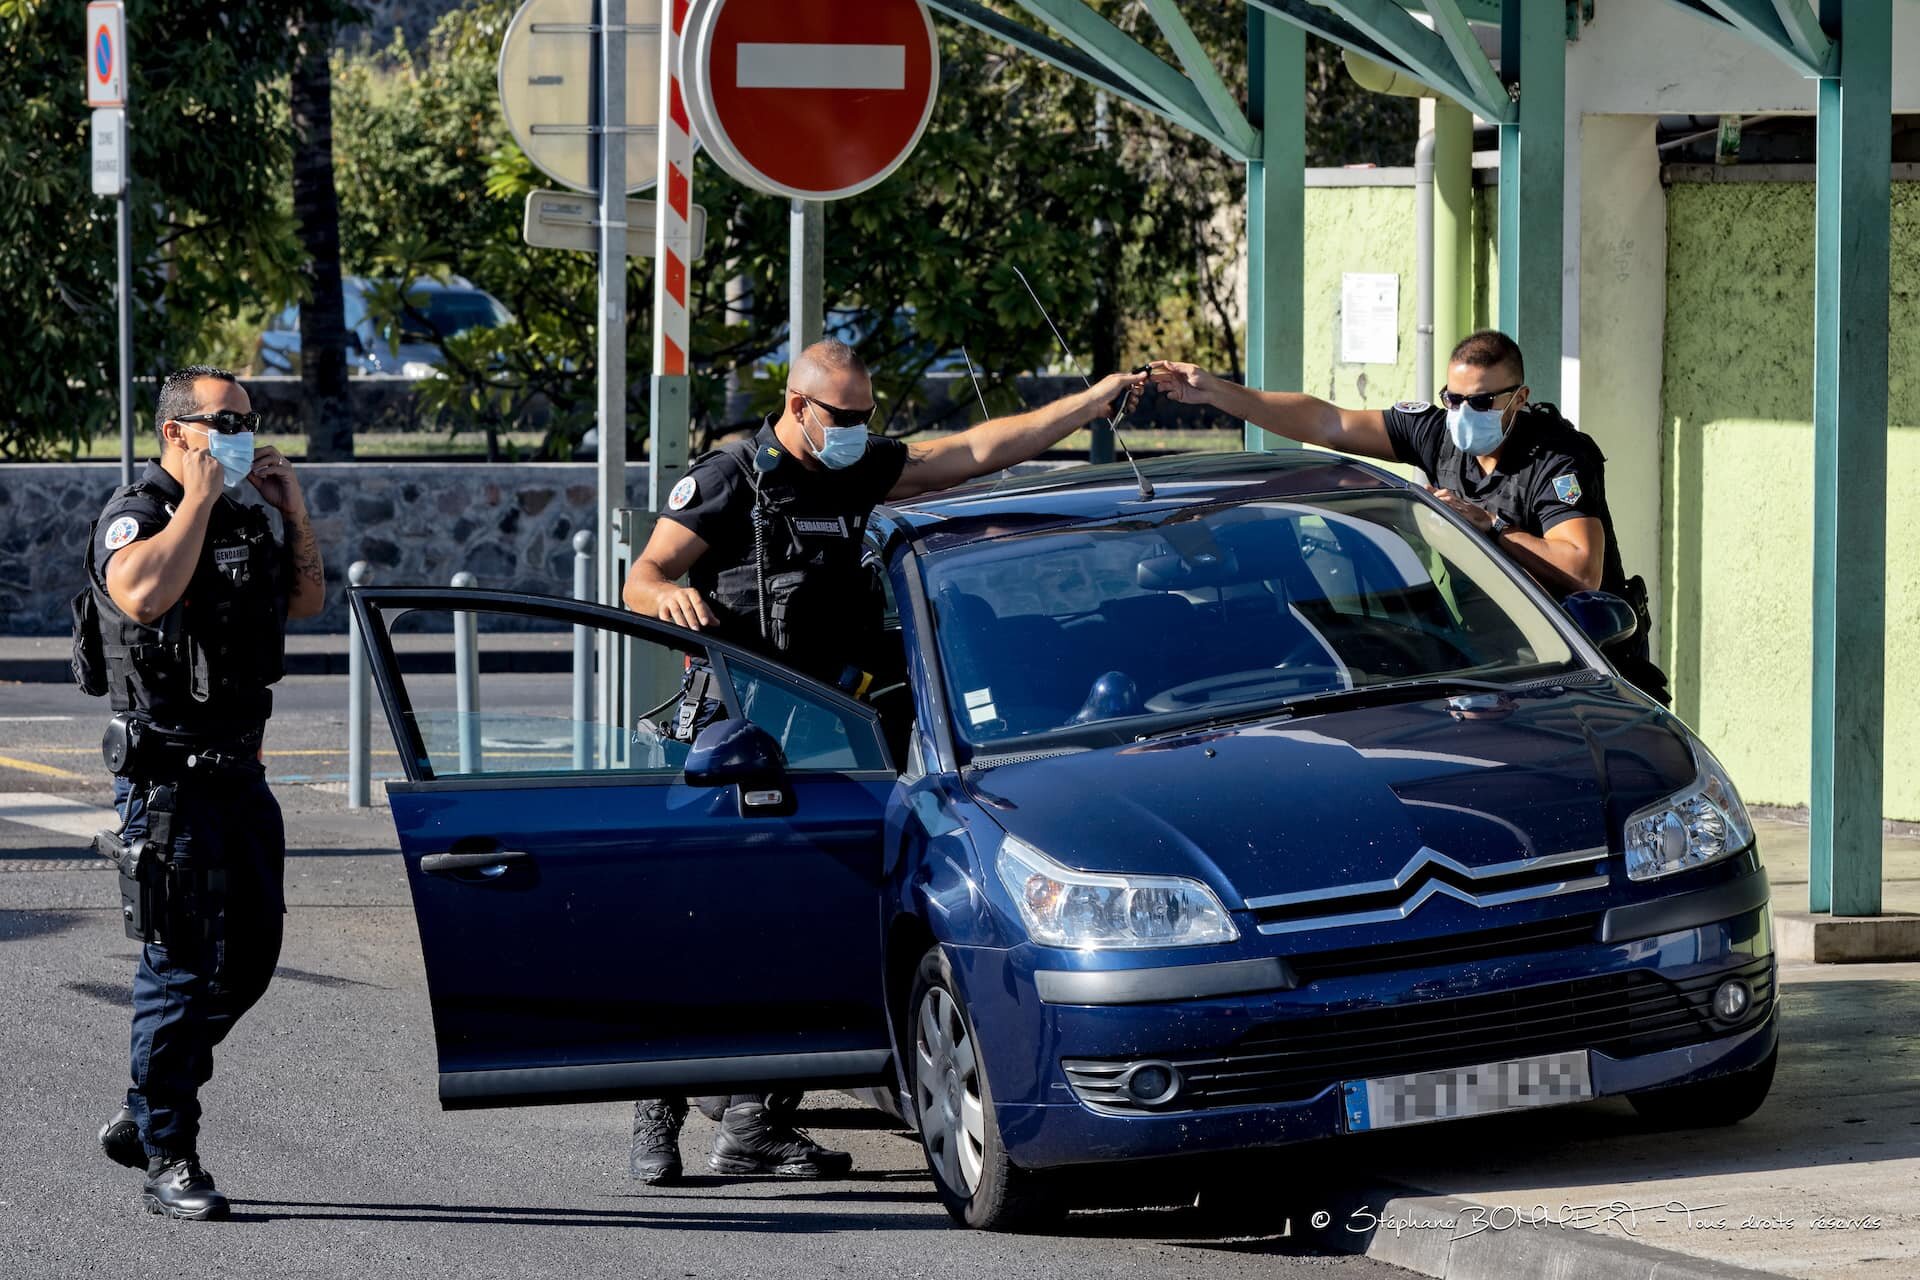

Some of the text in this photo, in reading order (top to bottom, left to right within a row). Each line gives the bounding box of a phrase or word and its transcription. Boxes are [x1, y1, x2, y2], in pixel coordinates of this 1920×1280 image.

[796, 520, 840, 532] GENDARMERIE
[216, 548, 248, 561] GENDARM
[1353, 1111, 1363, 1124] F
